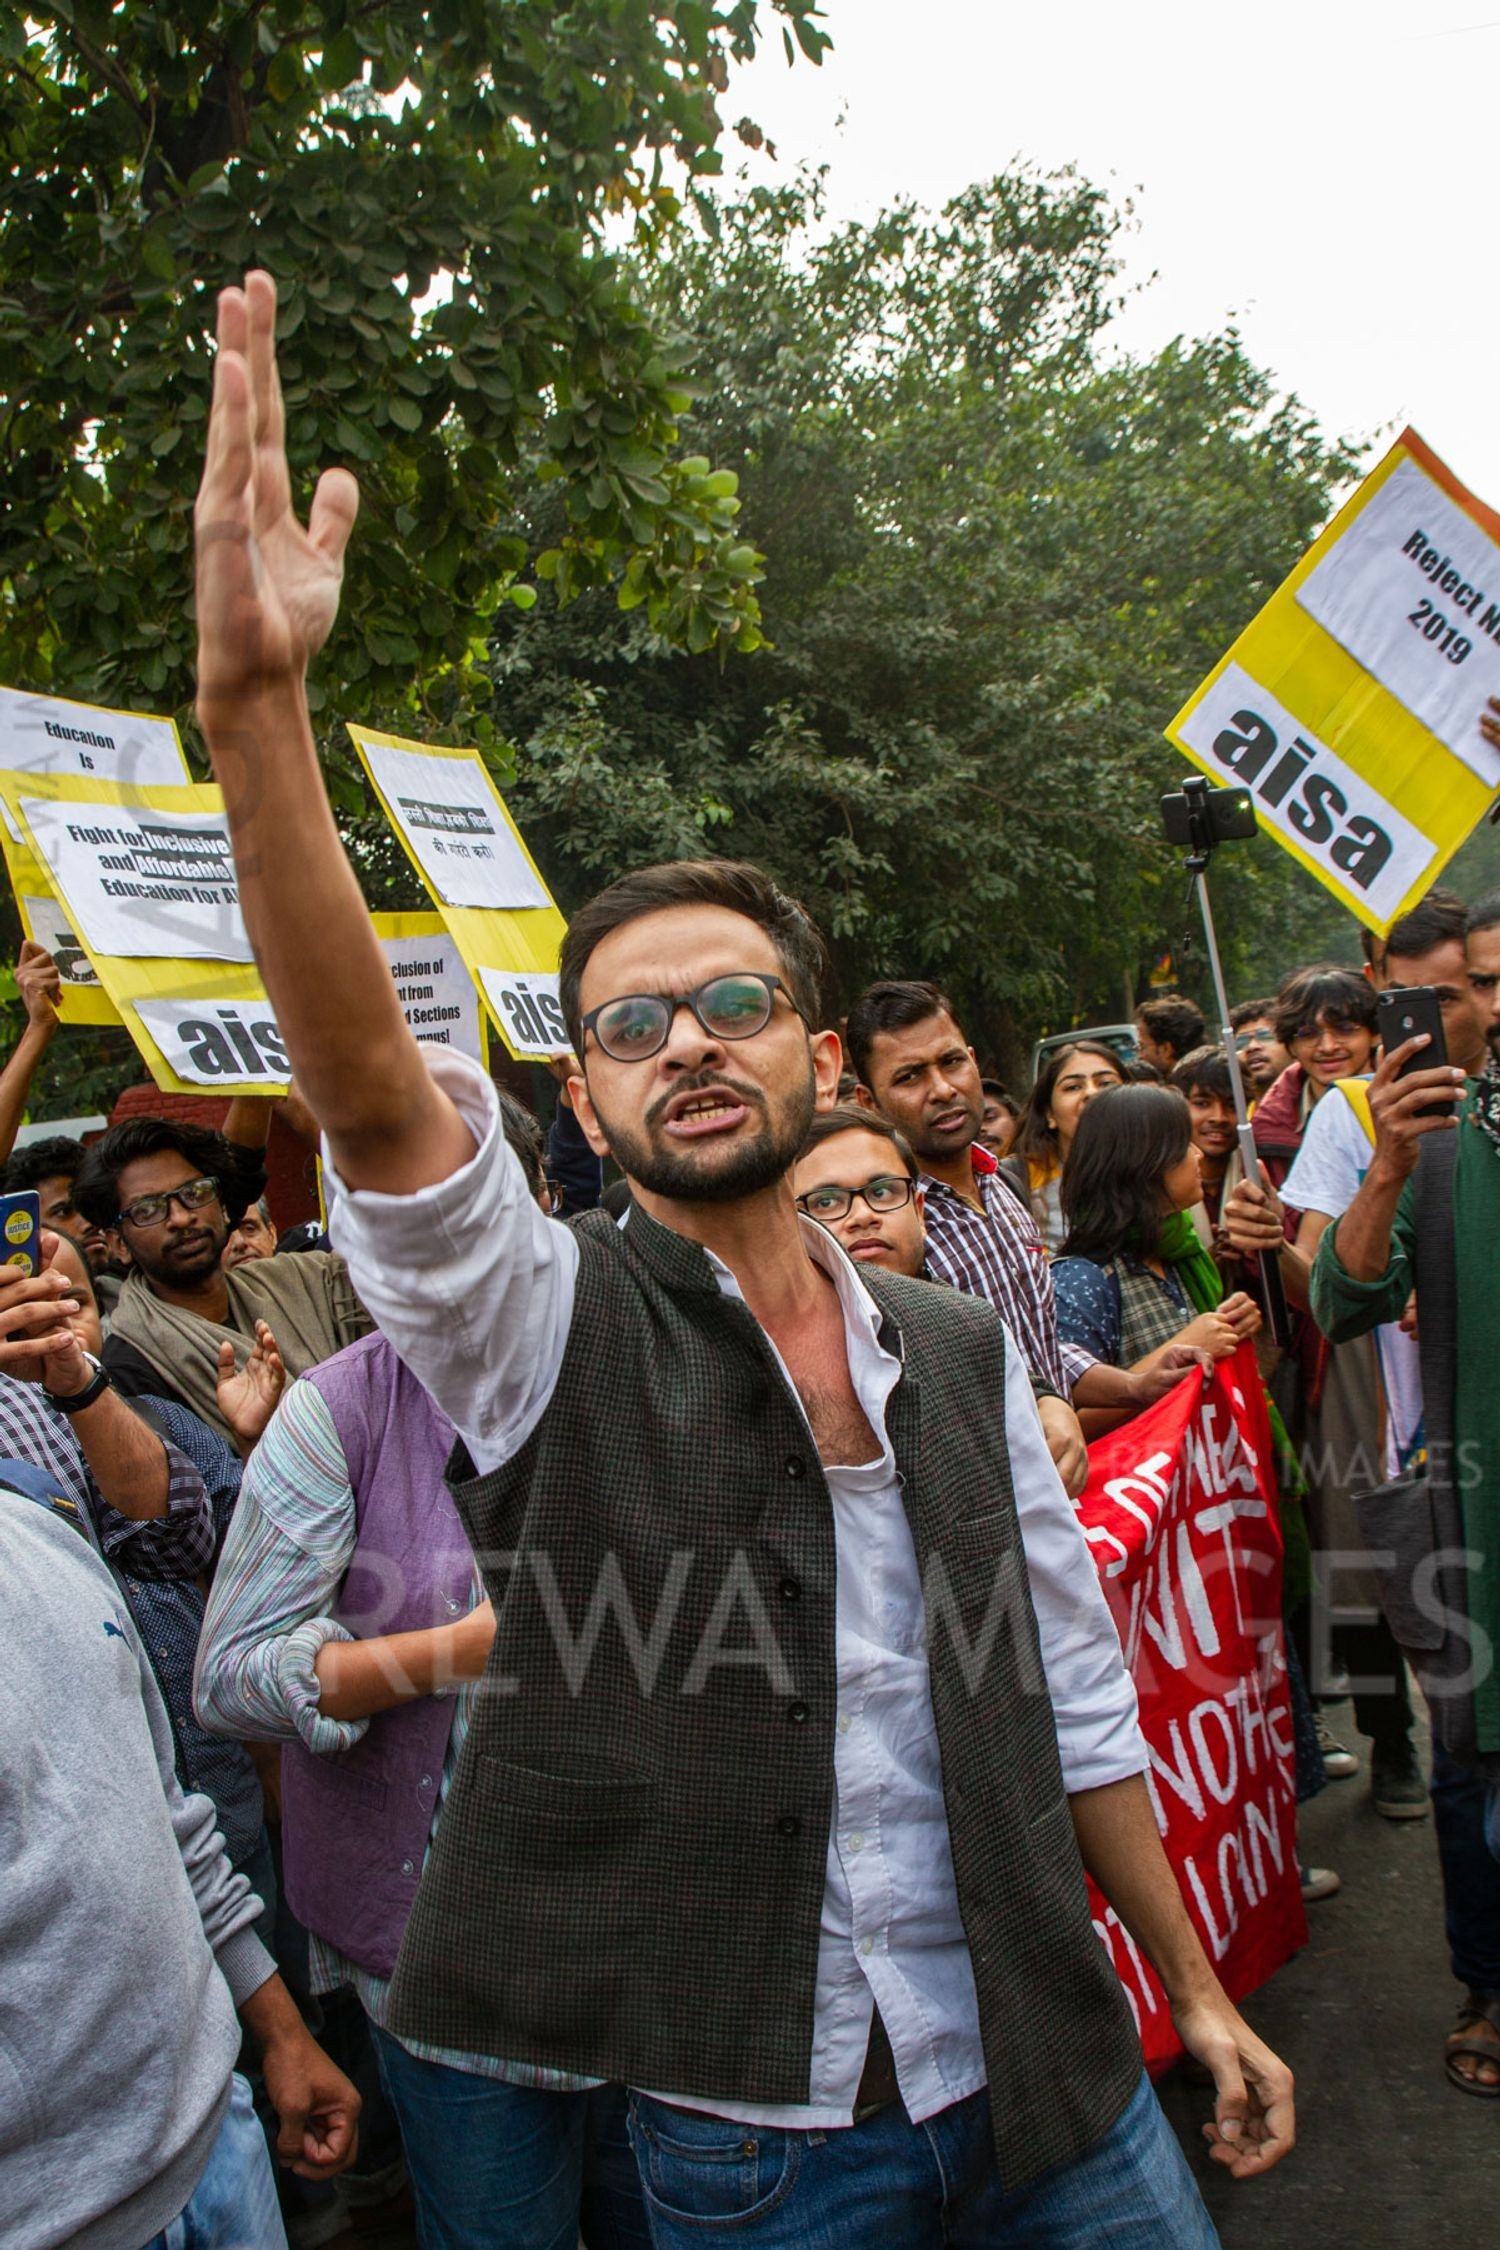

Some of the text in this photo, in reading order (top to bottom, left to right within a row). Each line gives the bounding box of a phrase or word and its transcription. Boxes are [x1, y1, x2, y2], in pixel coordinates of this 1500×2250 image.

[1402, 528, 1485, 617] Reject
[1408, 597, 1473, 666] 2019
[44, 720, 116, 750] Education
[1212, 709, 1394, 890] aisa
[66, 824, 231, 855] Fight for Inclusive
[99, 855, 231, 879] and Affordable
[101, 878, 195, 904] Education
[193, 886, 220, 905] for
[432, 958, 444, 975] of
[407, 984, 434, 1001] from
[413, 1005, 460, 1025] Sections
